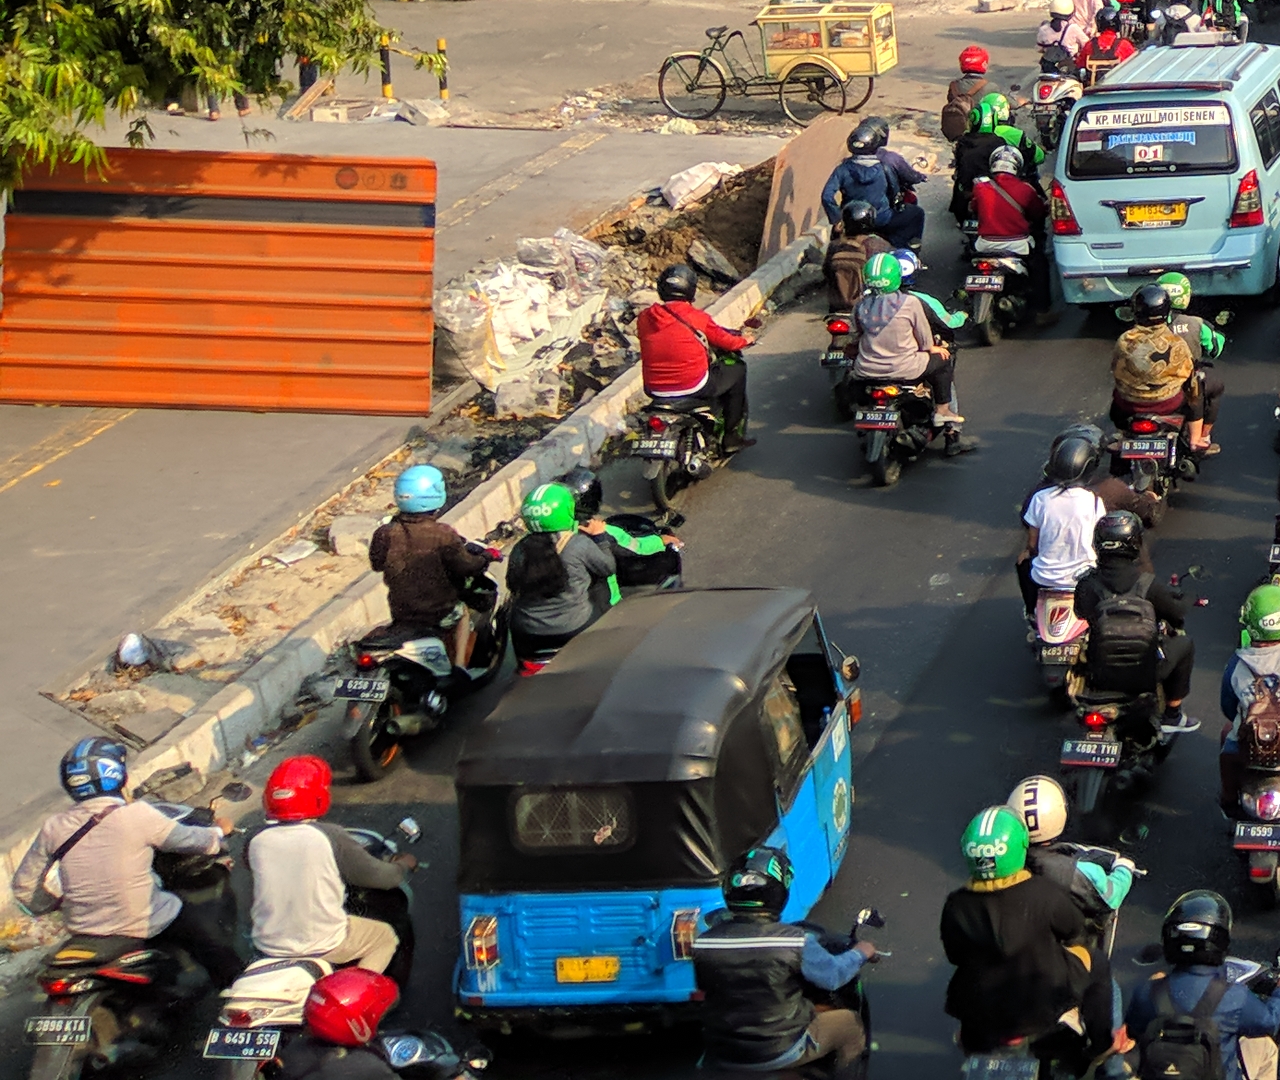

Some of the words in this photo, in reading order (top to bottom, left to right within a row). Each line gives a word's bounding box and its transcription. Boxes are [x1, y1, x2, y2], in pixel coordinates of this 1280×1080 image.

[1095, 115, 1109, 125] KP.
[1112, 112, 1152, 125] MELAYU
[1183, 110, 1216, 122] SENEN
[1261, 617, 1275, 628] GO
[1250, 826, 1273, 837] 6599
[967, 839, 1008, 858] Grab
[64, 1020, 86, 1032] KTA
[223, 1031, 251, 1044] 6451
